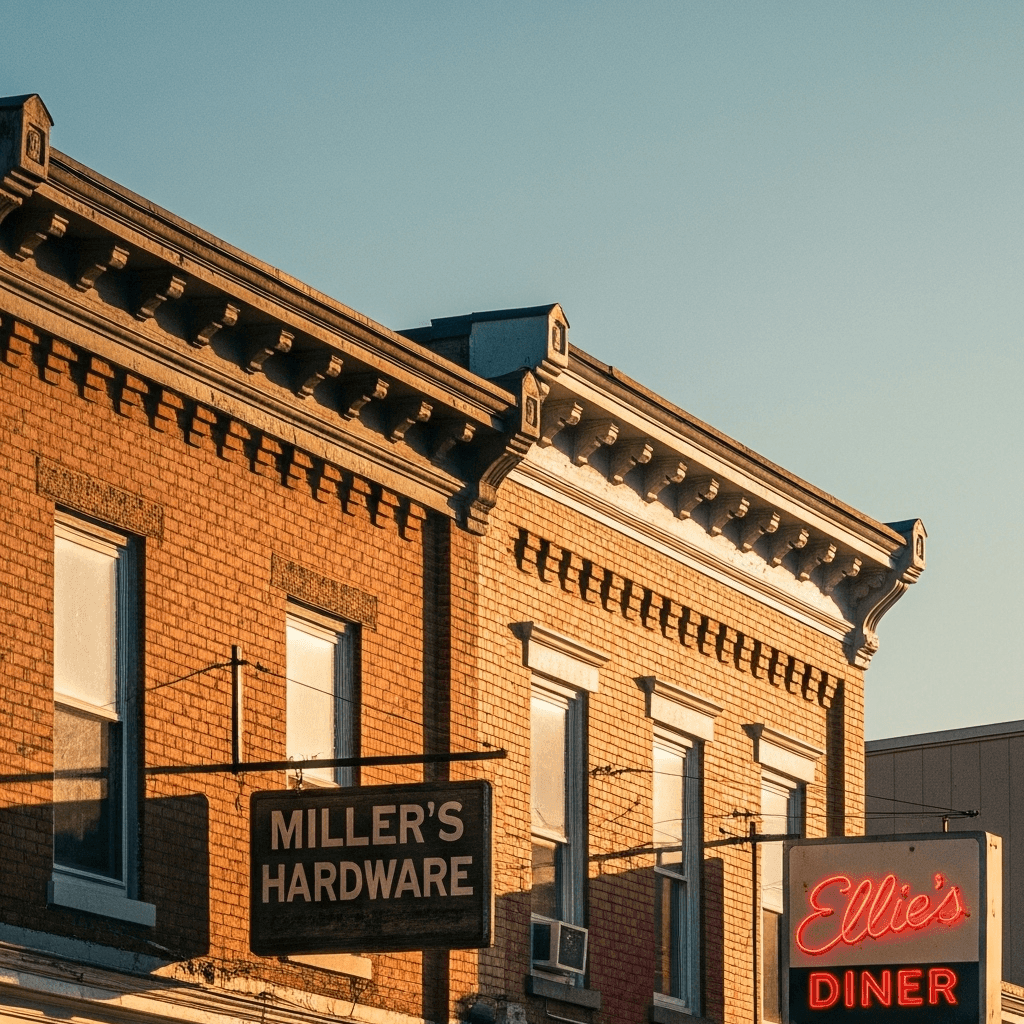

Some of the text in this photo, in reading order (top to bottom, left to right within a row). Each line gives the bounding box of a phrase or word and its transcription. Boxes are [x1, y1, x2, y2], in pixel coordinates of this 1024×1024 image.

[271, 801, 464, 850] MILLER'S
[262, 856, 474, 903] HARDWARE
[796, 873, 967, 955] Ellie's
[809, 968, 958, 1008] DINER
